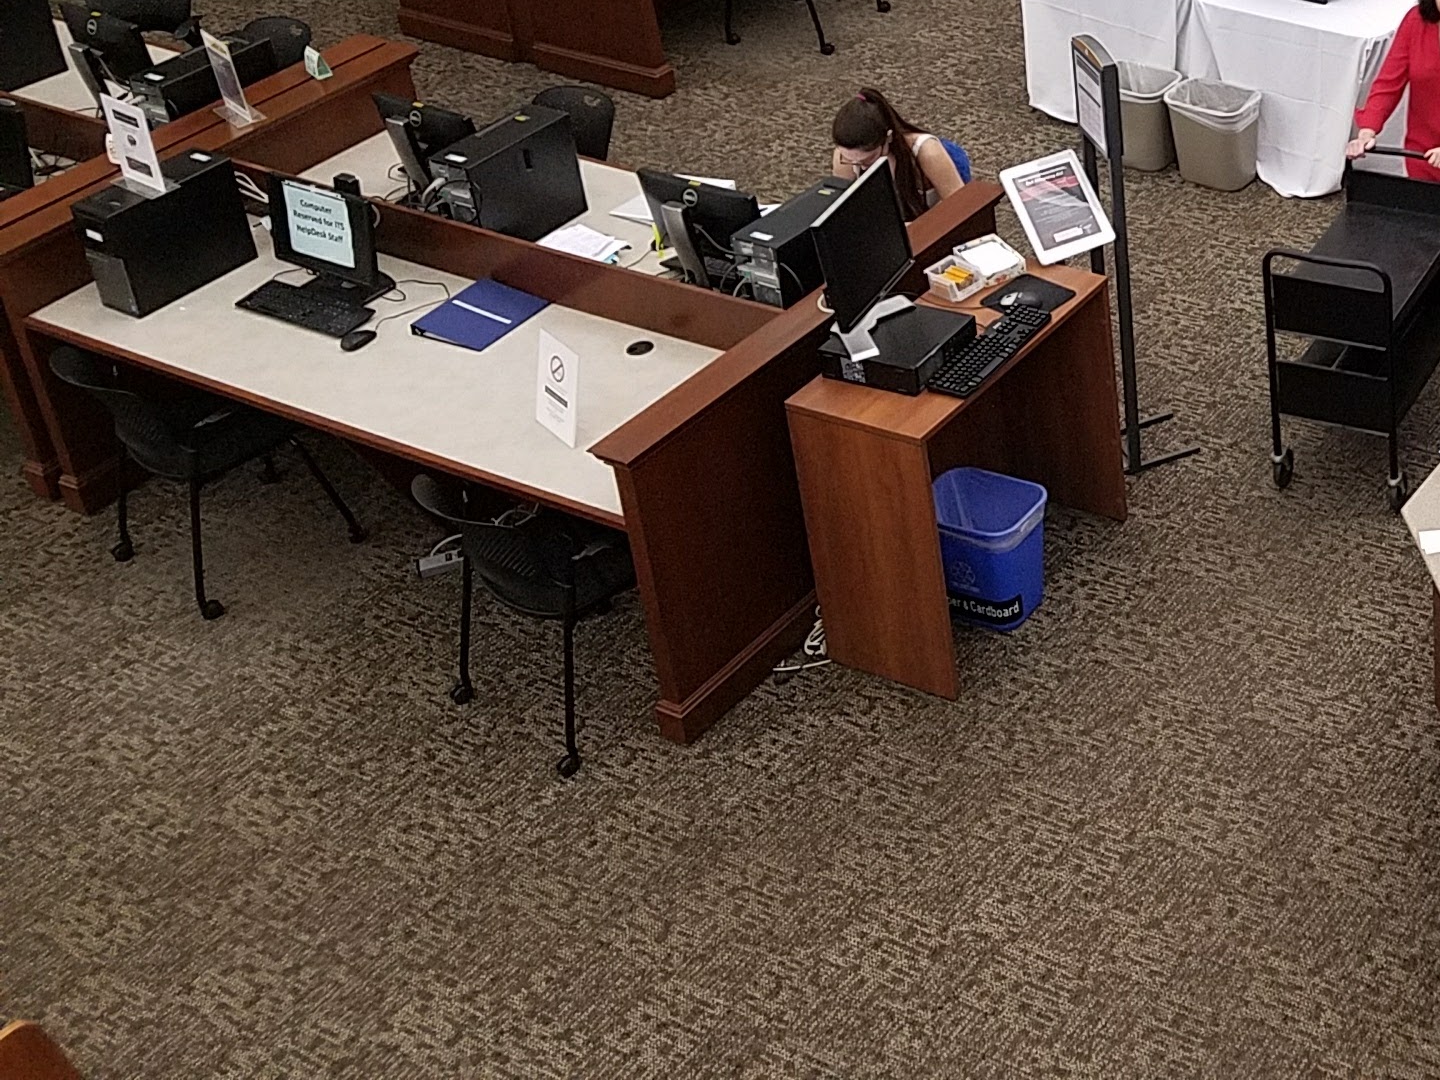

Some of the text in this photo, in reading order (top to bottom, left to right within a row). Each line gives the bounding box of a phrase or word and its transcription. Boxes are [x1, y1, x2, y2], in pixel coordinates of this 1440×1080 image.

[299, 199, 332, 214] Computer
[293, 209, 345, 230] Reserved for ITS
[296, 224, 343, 243] HelpDesk Staff
[970, 600, 1020, 618] Cardboard
